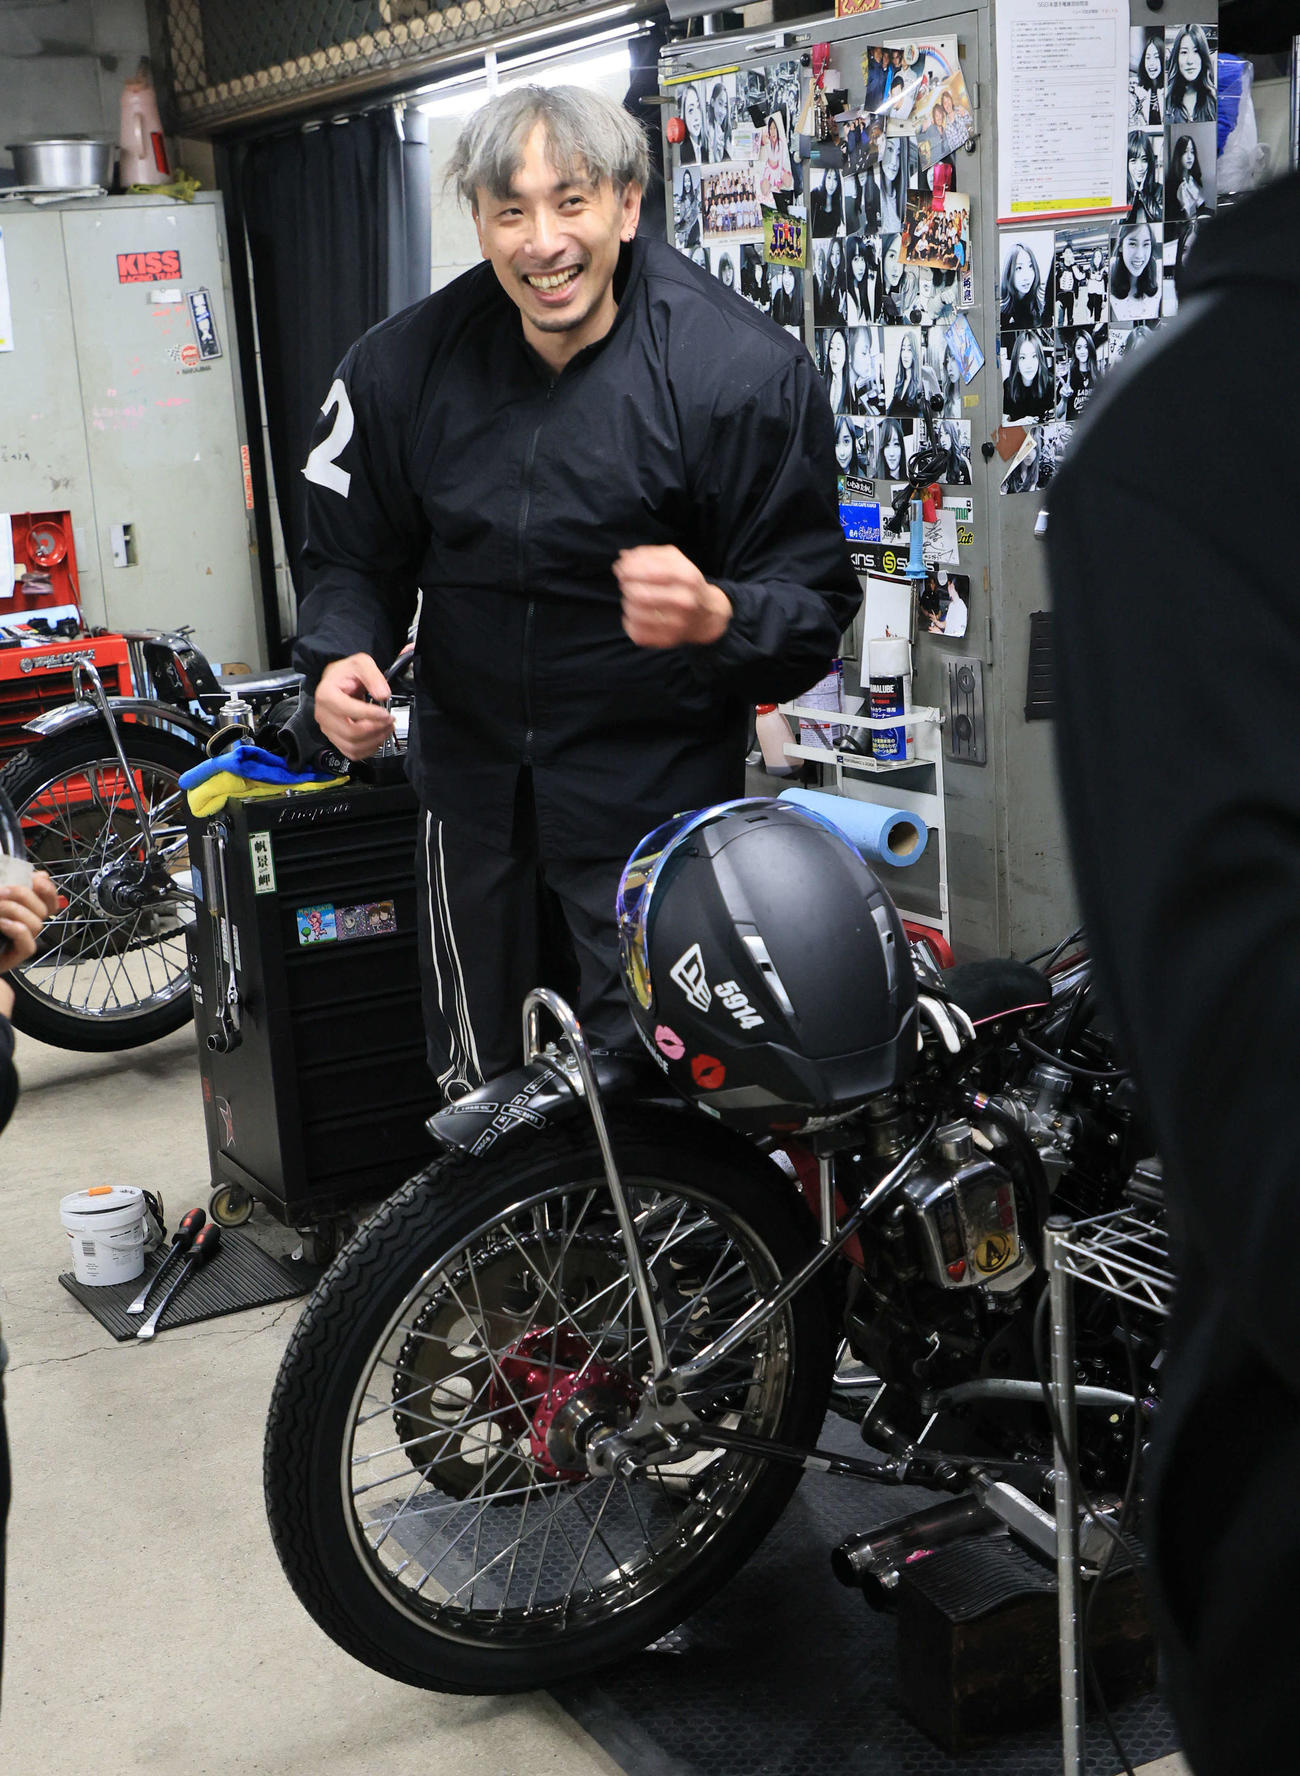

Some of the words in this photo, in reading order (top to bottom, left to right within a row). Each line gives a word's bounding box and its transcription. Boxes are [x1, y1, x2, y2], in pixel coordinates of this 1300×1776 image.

[117, 250, 180, 276] KISS
[300, 378, 354, 498] 2
[714, 980, 765, 1030] 5914
